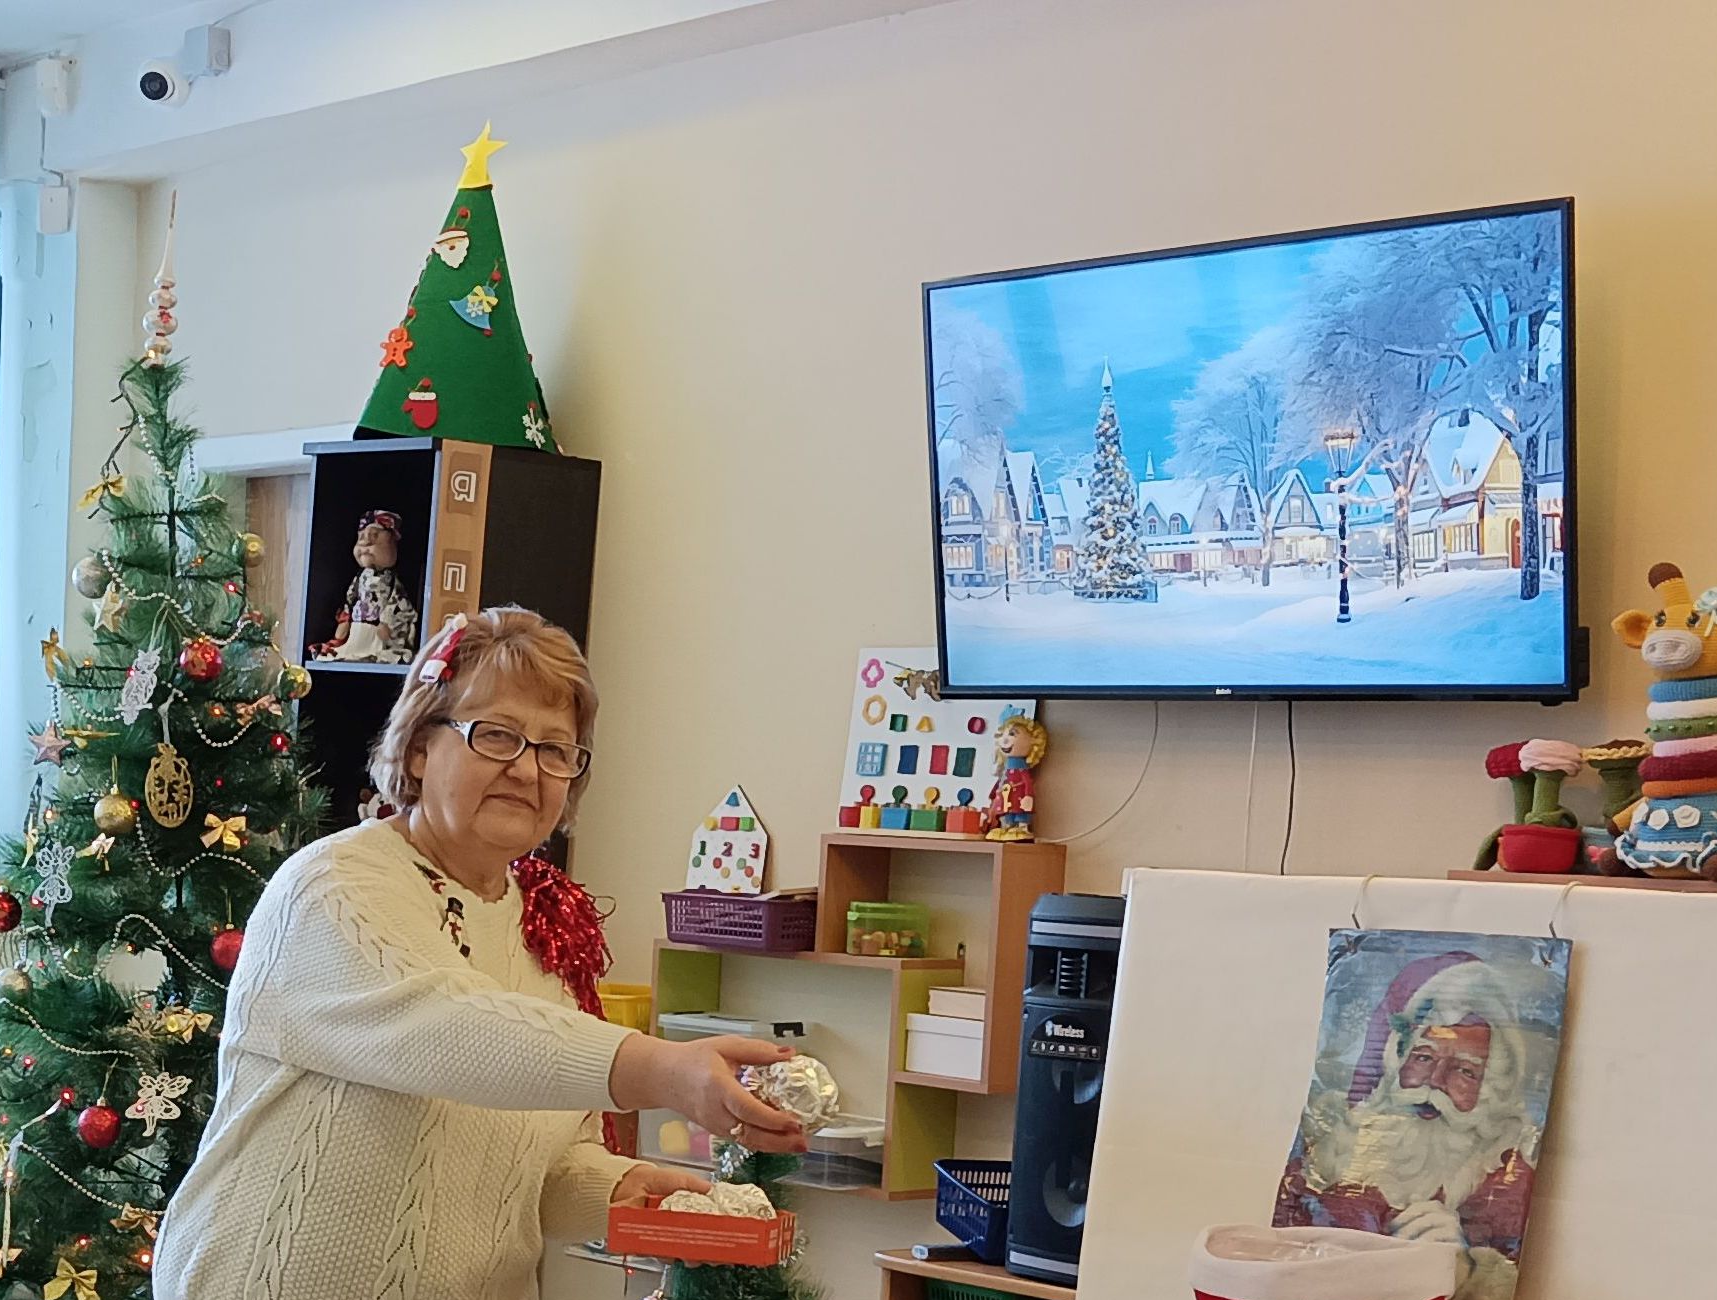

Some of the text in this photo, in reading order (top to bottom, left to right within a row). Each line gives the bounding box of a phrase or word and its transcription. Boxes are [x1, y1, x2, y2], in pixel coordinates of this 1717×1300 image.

[698, 840, 761, 859] 1 2 3
